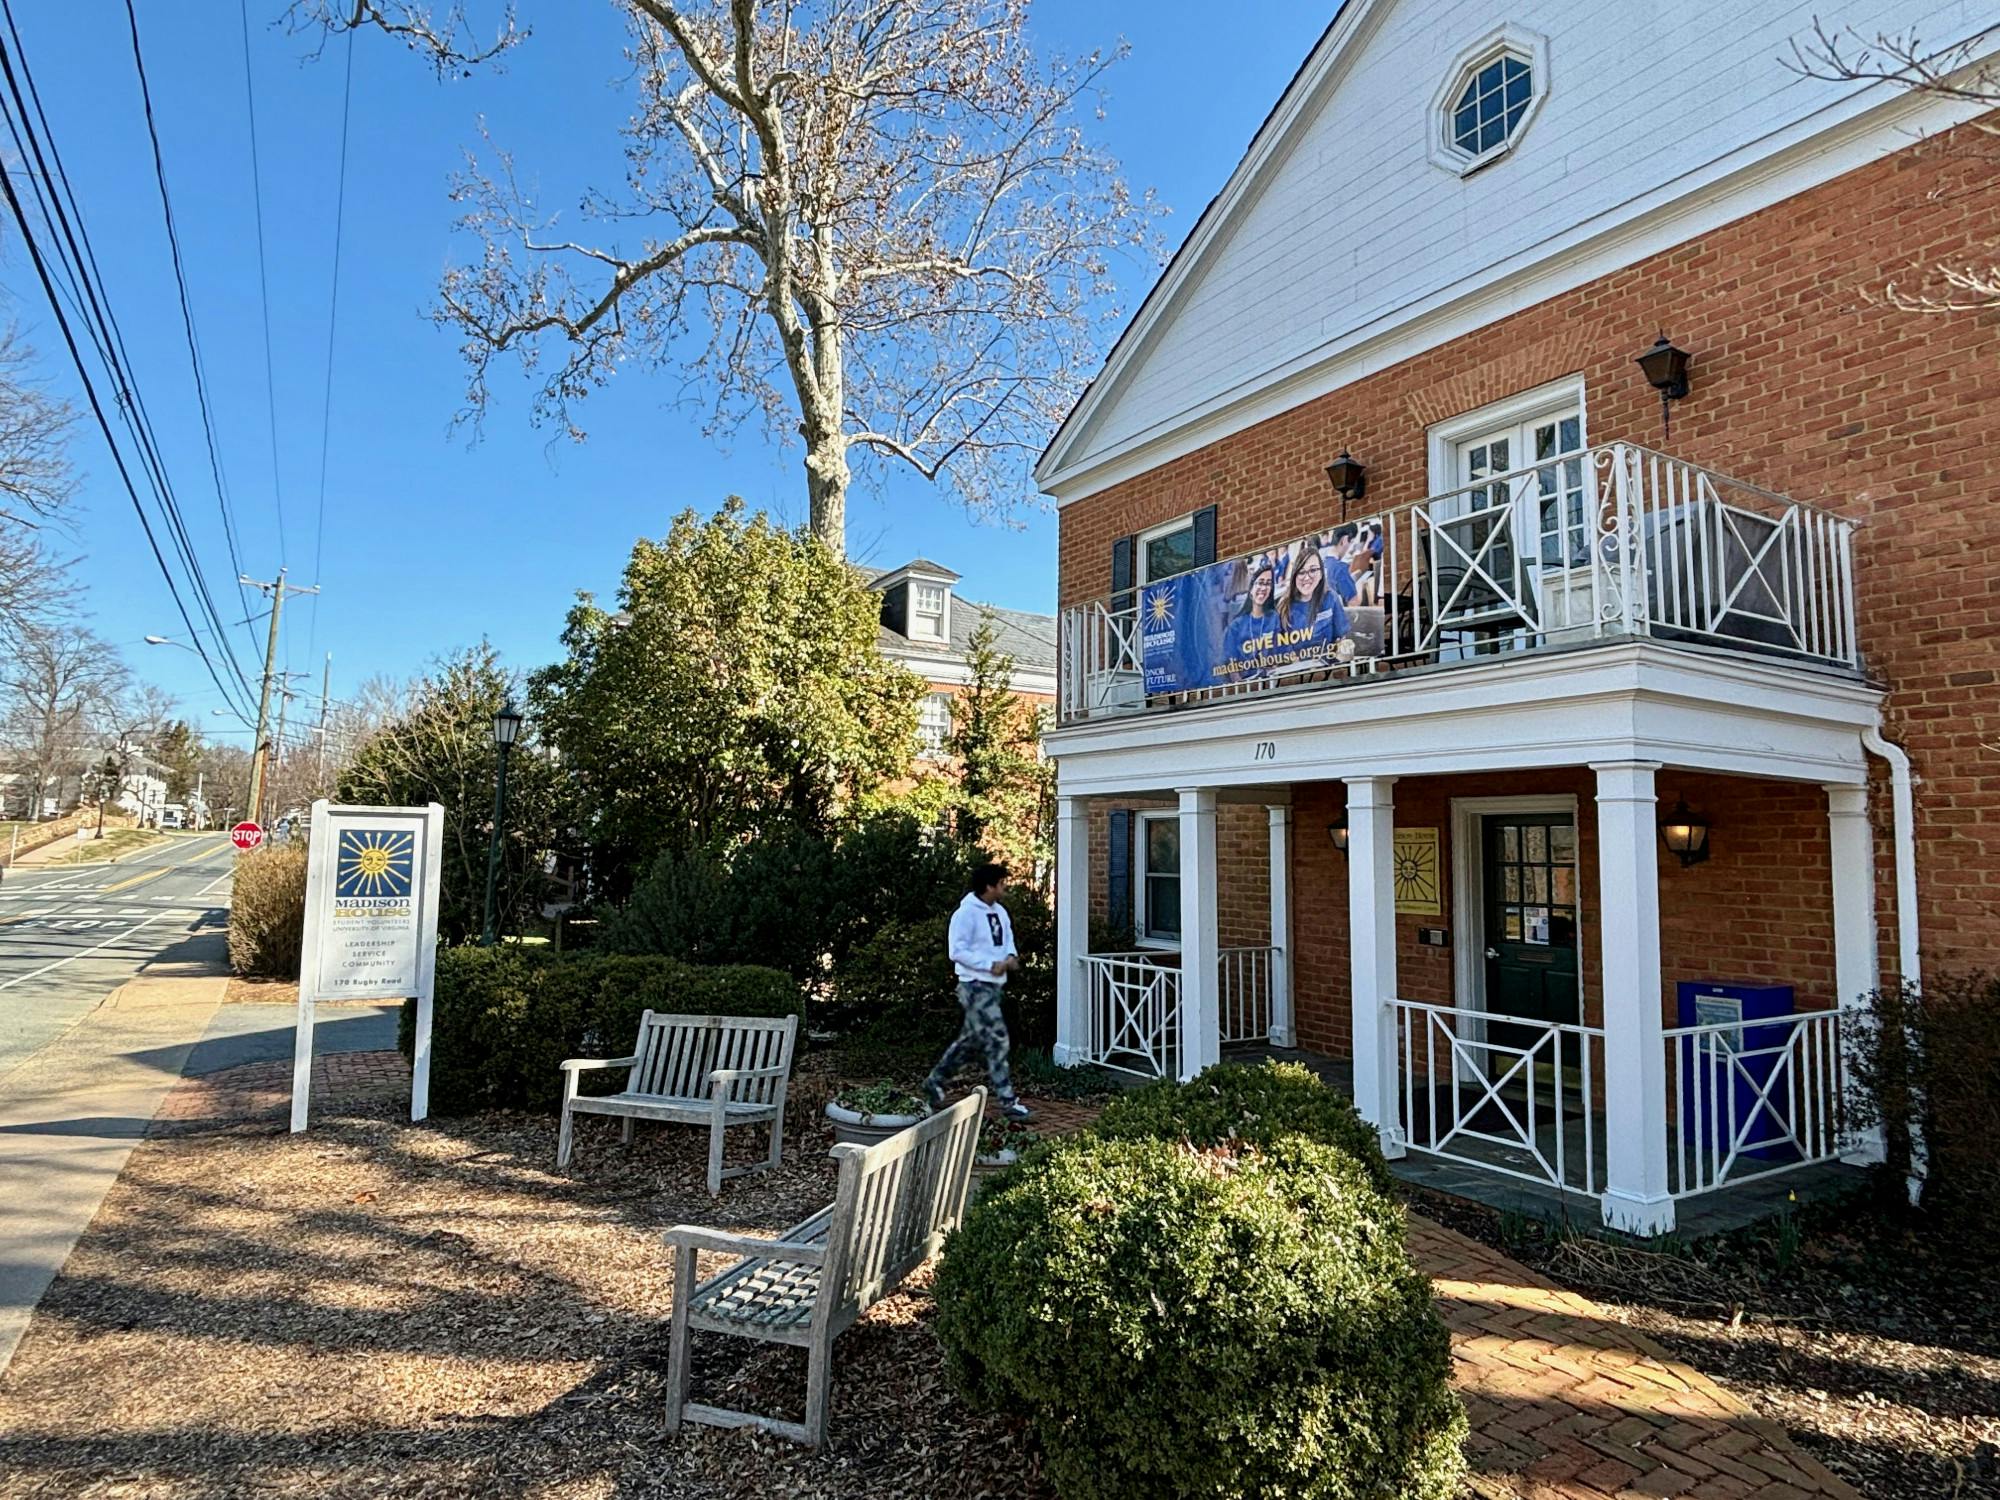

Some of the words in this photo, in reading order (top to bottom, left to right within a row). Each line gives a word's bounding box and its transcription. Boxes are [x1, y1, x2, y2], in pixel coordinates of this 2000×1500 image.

[1242, 631, 1274, 654] GIVE
[1277, 626, 1314, 646] NOW
[1254, 742, 1275, 760] 170
[233, 830, 261, 842] STOP
[381, 977, 402, 985] Road
